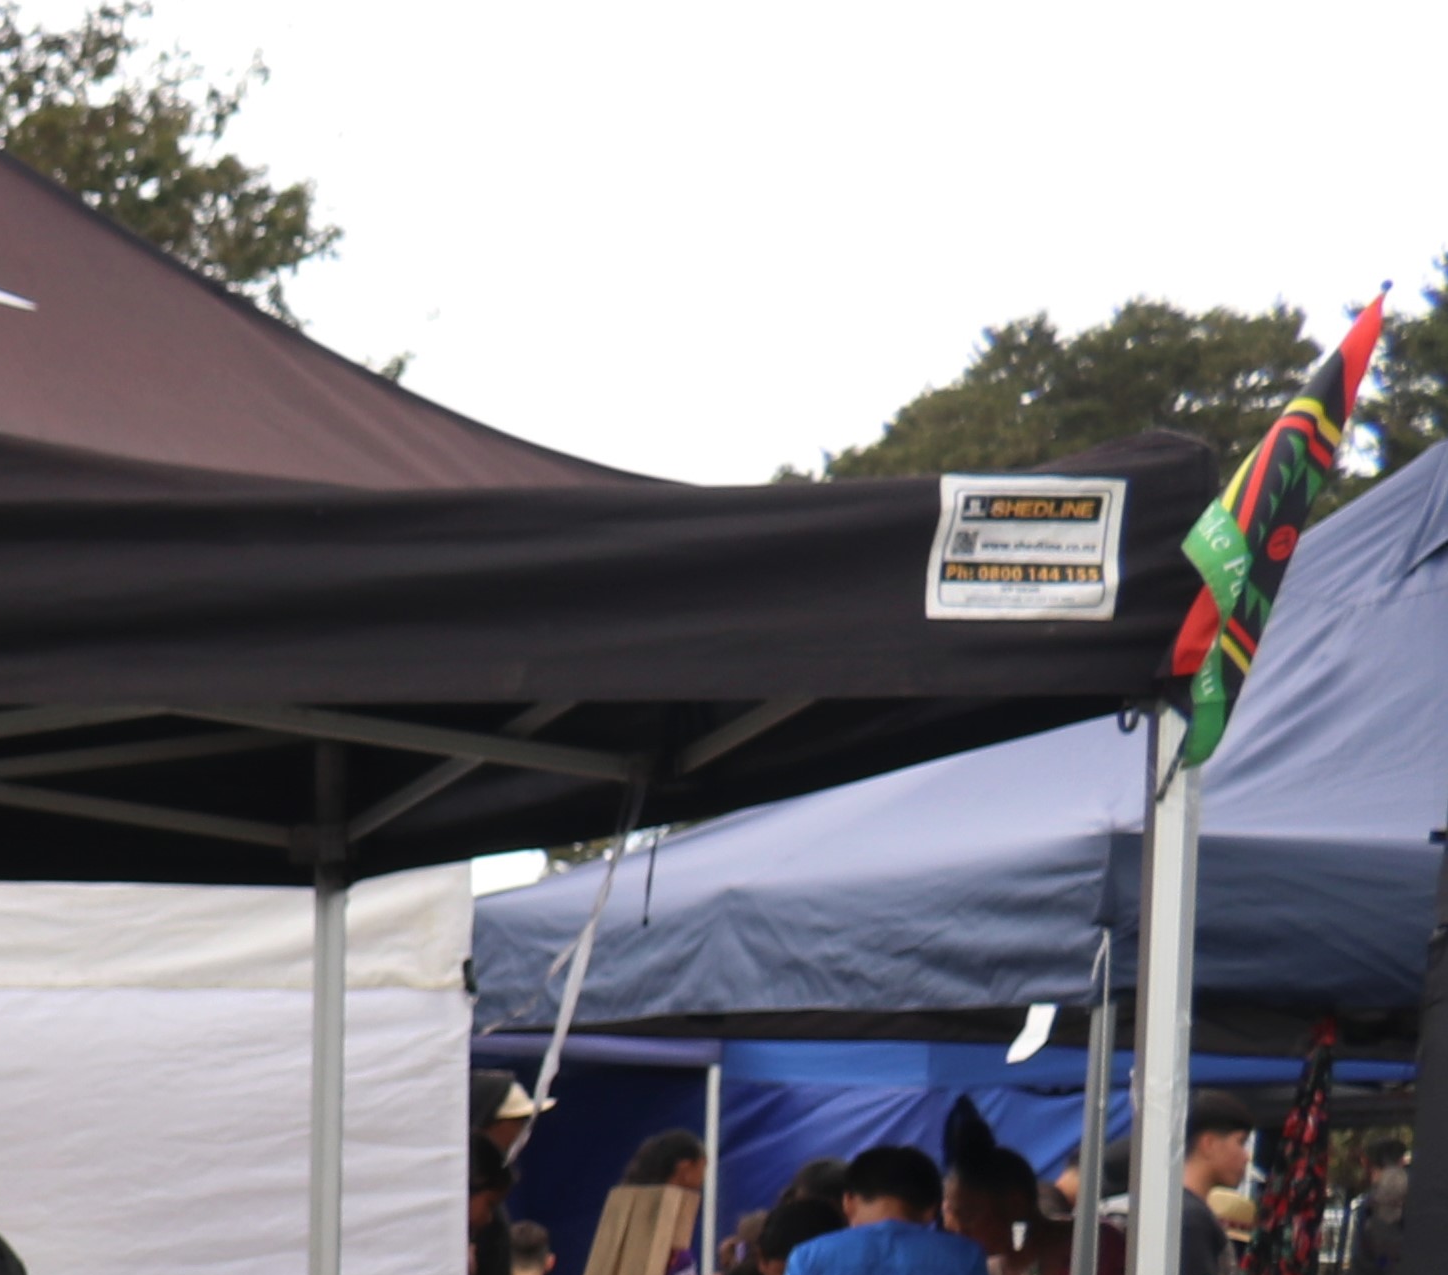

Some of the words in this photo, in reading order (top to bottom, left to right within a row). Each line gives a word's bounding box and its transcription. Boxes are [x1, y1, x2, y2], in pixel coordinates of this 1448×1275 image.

[990, 500, 1095, 518] SHEDLINE
[945, 563, 974, 580] Ph:
[978, 564, 1023, 581] 0800
[1029, 565, 1061, 581] 144
